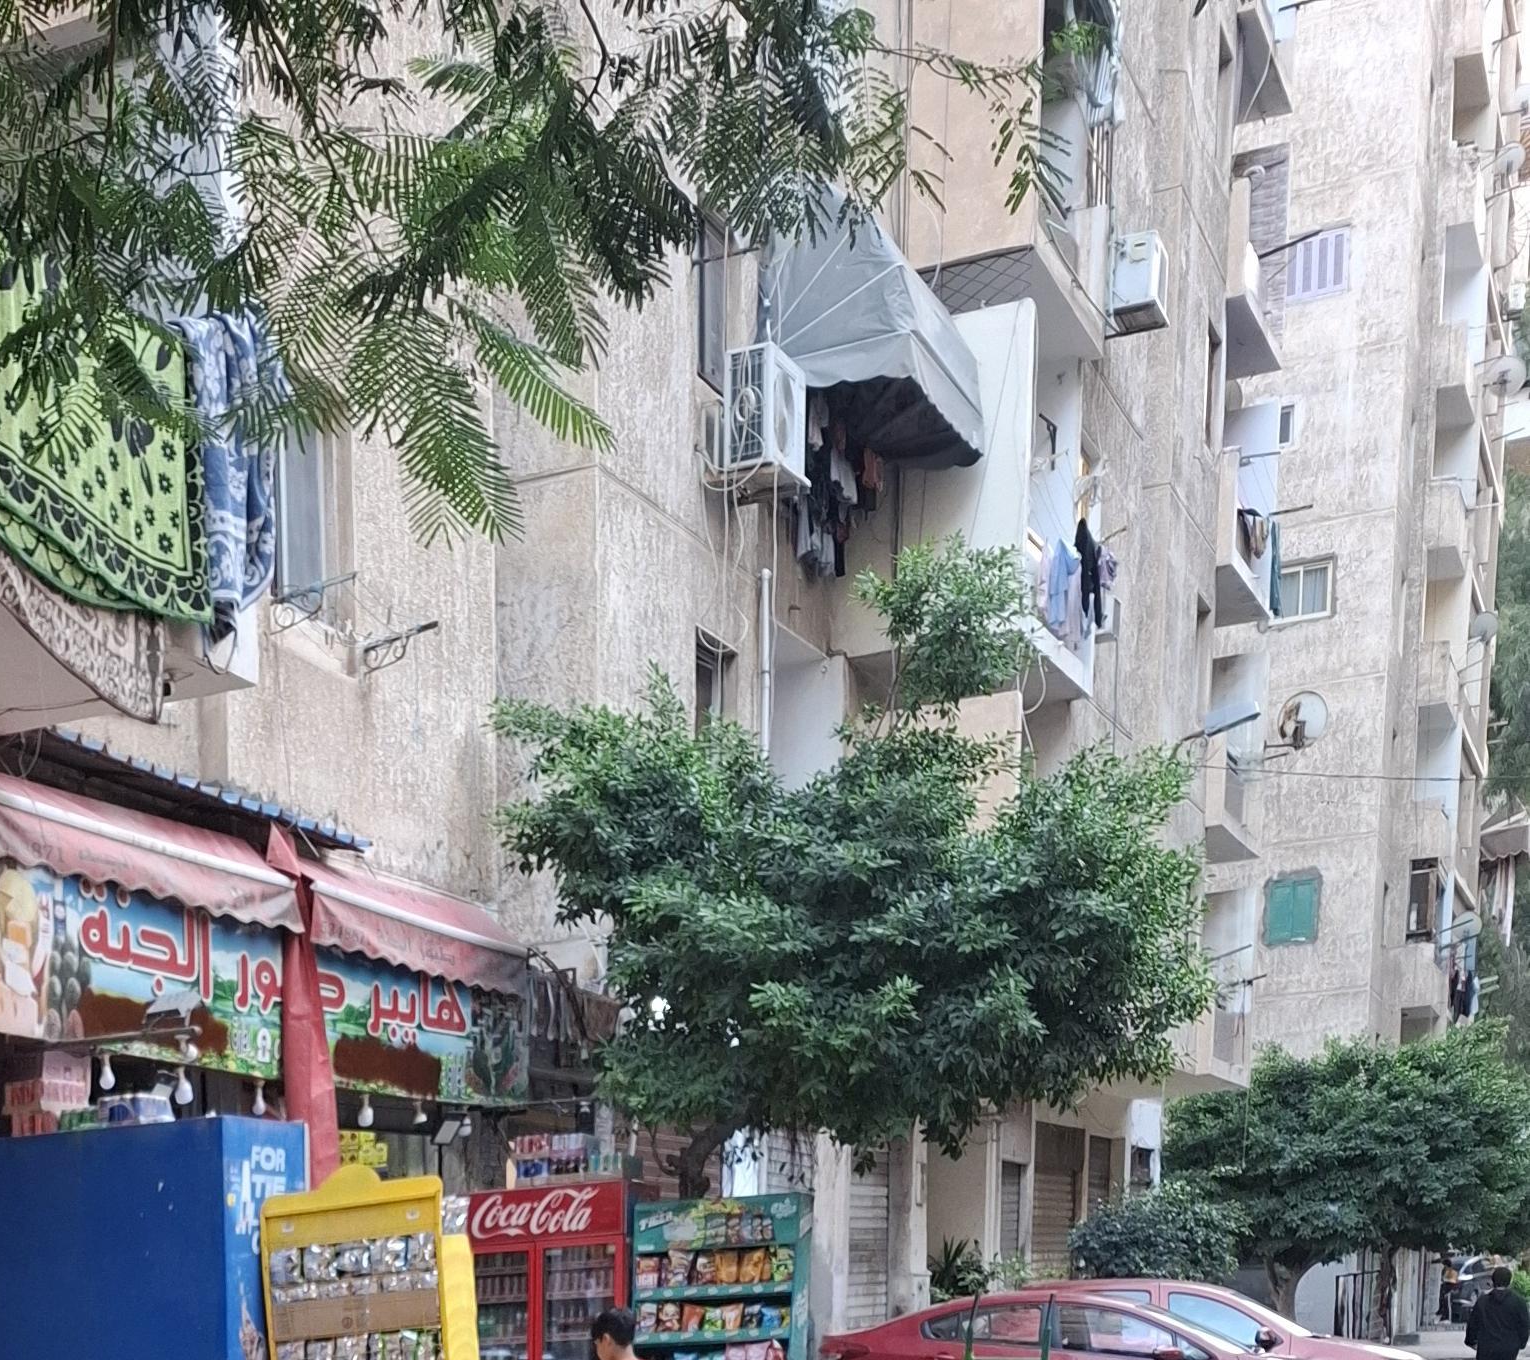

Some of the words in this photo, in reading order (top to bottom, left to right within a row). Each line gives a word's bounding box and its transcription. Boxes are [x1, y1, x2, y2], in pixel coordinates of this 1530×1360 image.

[367, 974, 470, 1044] هايبر
[250, 1145, 286, 1172] FOR
[471, 1185, 600, 1240] Coca-Cola
